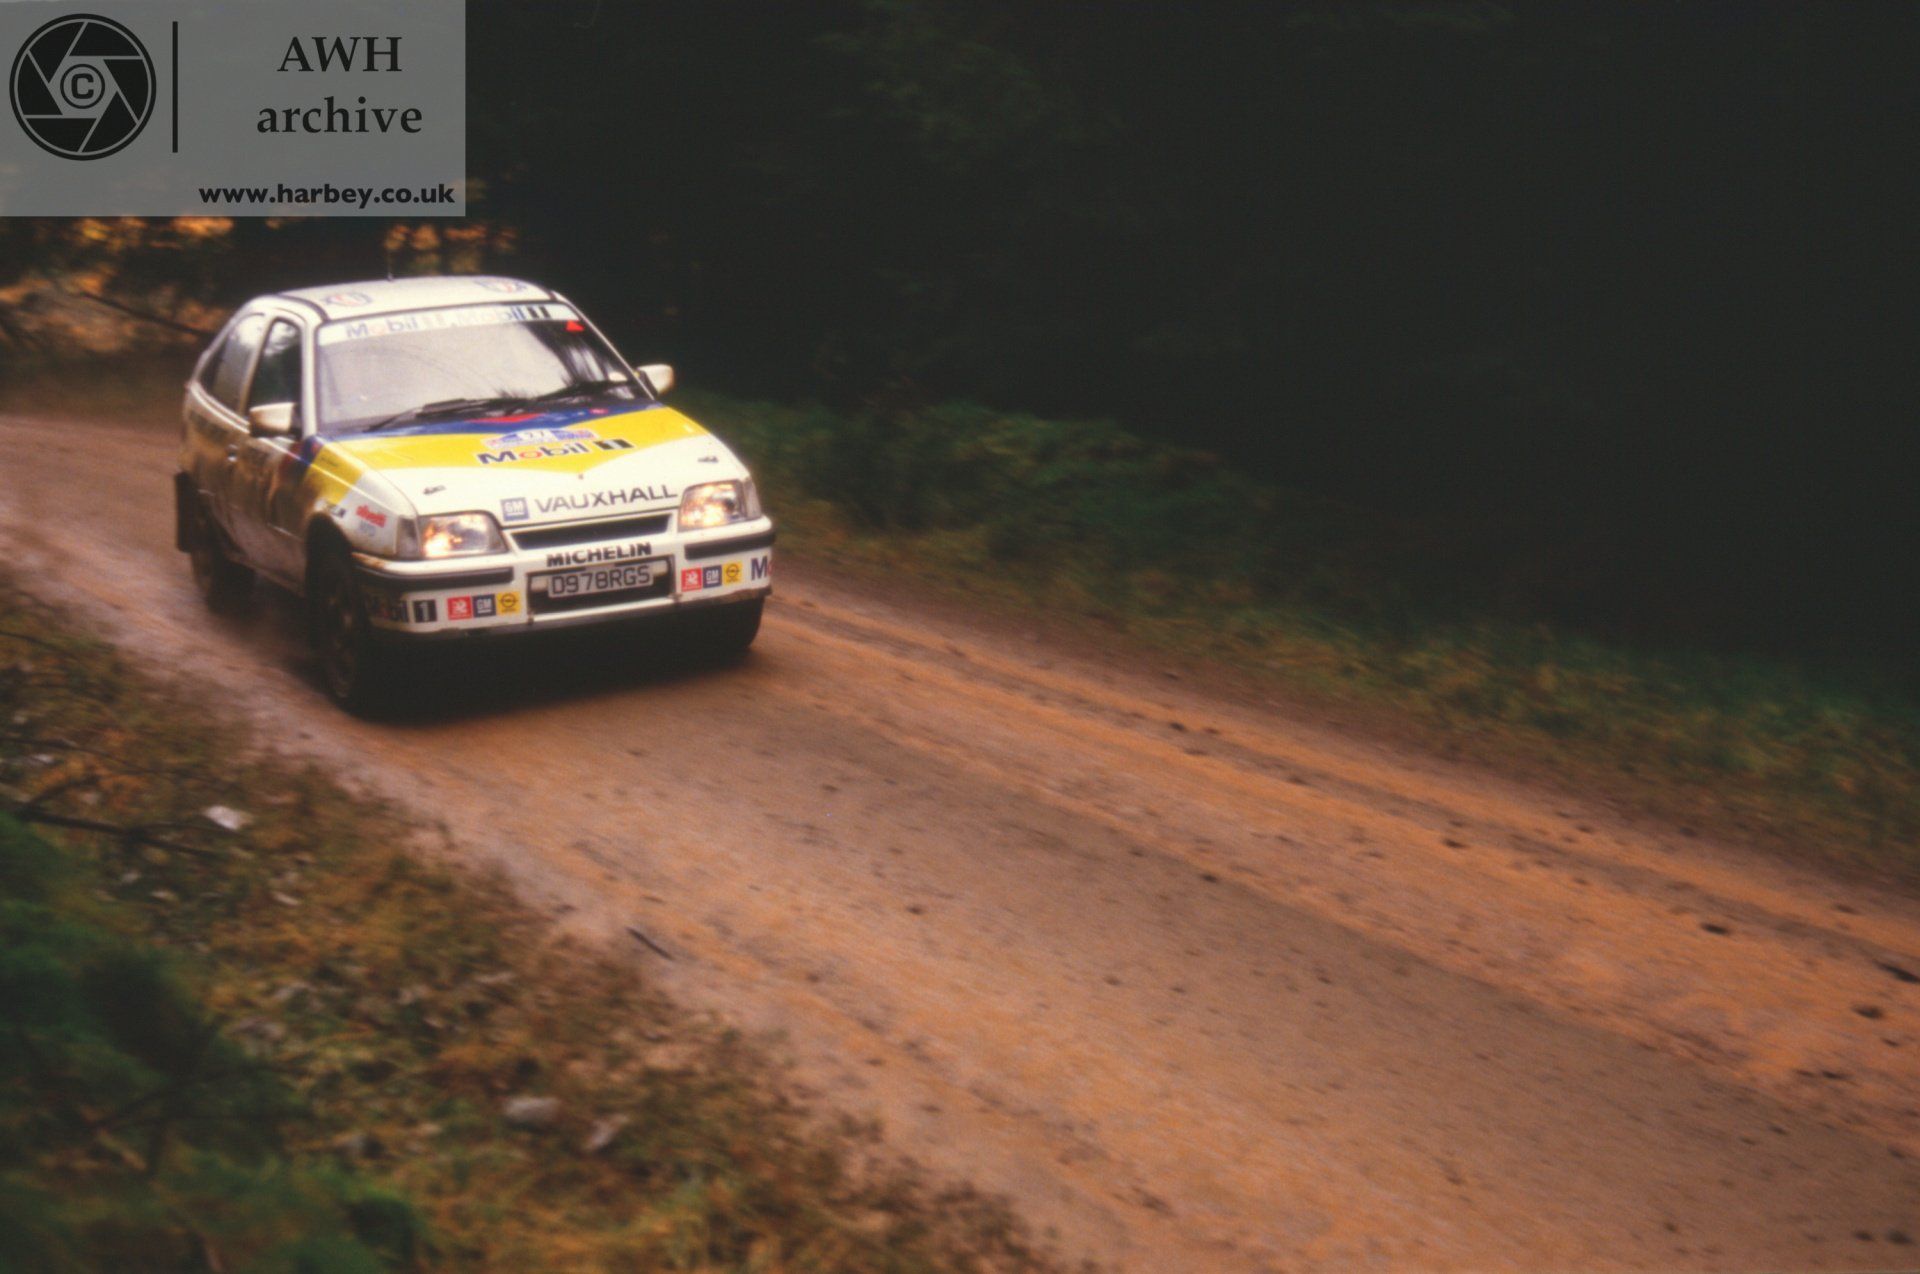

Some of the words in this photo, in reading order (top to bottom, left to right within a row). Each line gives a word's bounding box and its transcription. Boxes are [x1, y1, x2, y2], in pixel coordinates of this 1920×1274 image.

[345, 312, 419, 338] Mobil
[477, 441, 590, 465] Mobil
[534, 484, 678, 514] VAUXHALL
[546, 541, 653, 567] MICHELIN
[551, 565, 650, 595] D978RGS
